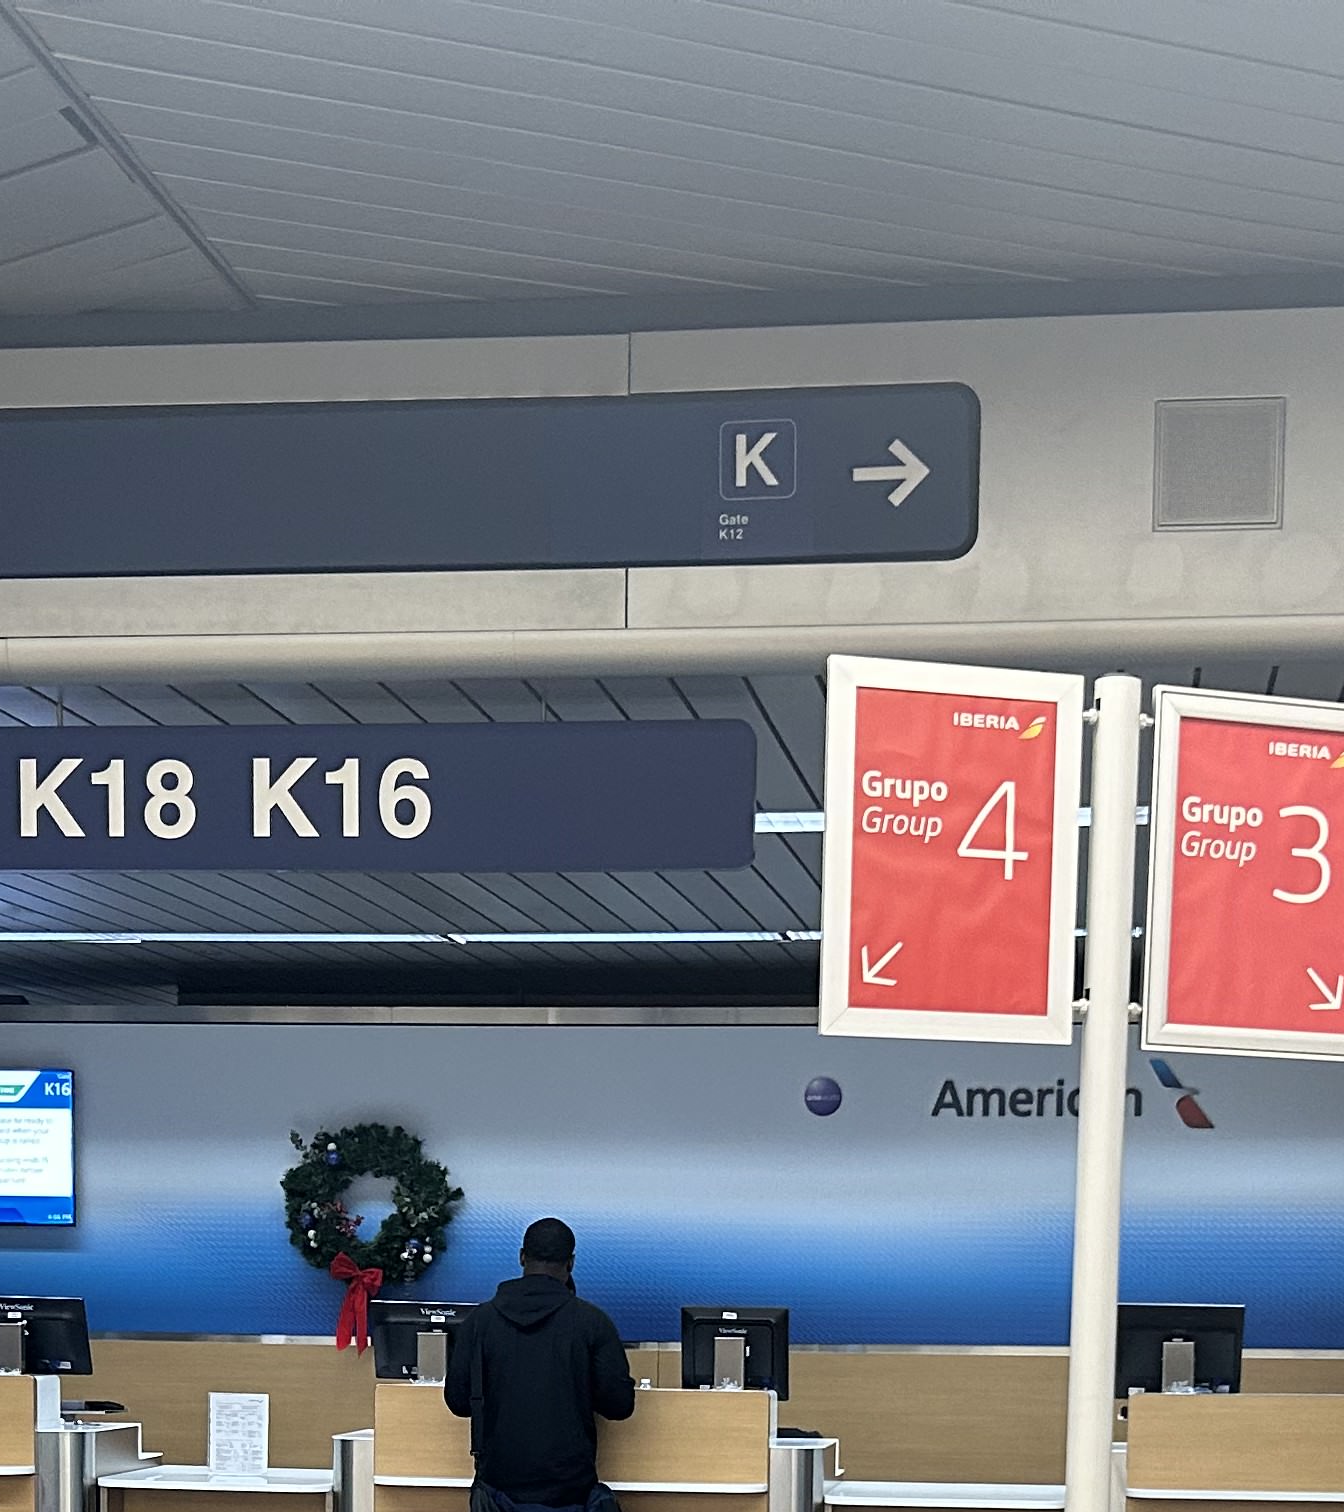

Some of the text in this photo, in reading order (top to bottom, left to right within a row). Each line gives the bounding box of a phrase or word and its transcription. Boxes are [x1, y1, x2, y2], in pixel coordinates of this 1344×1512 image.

[735, 432, 779, 487] K
[719, 513, 749, 526] Gate
[719, 528, 744, 540] K12
[953, 712, 1019, 731] IBERIA
[1268, 741, 1331, 761] IBERIA
[19, 756, 432, 841] K18 K16
[862, 770, 948, 807] Grupo
[861, 806, 943, 844] Group
[957, 780, 1029, 881] 4
[1182, 795, 1264, 832] Grupo
[1181, 830, 1257, 868] Group
[1272, 805, 1331, 904] 3
[44, 1081, 71, 1096] K16
[931, 1078, 1143, 1117] Americn
